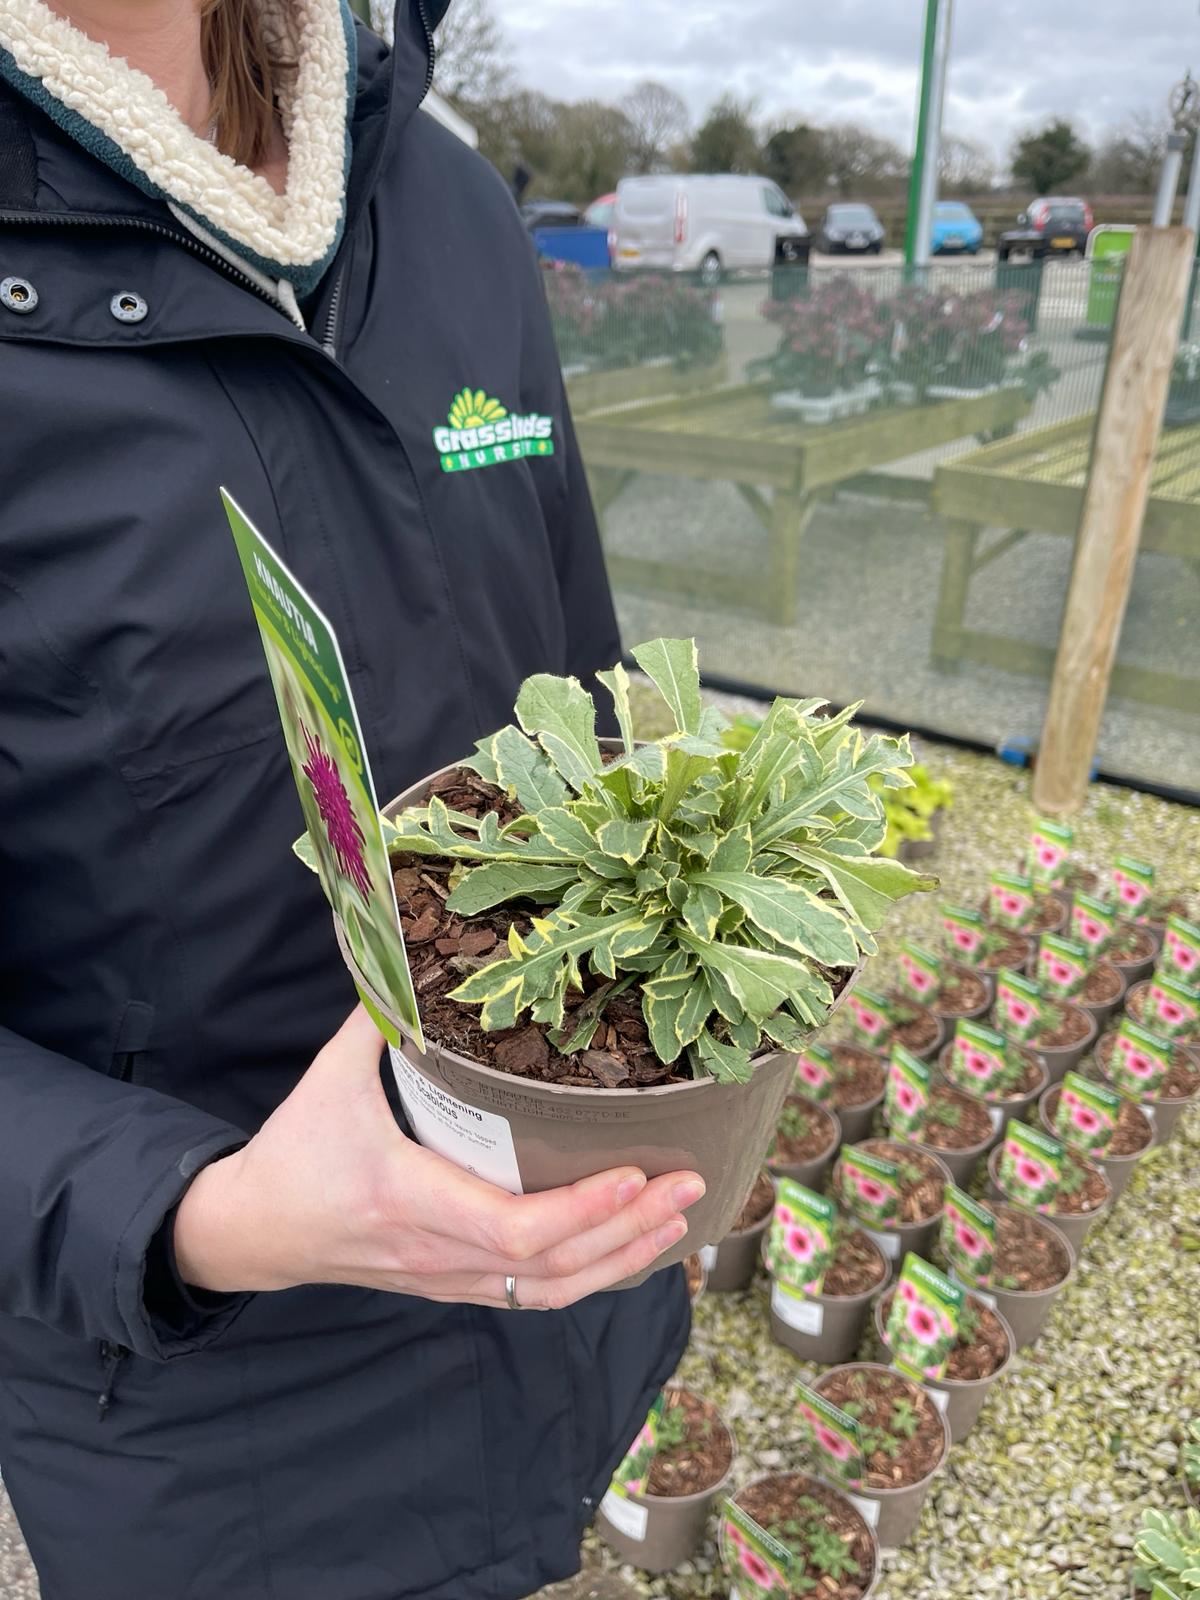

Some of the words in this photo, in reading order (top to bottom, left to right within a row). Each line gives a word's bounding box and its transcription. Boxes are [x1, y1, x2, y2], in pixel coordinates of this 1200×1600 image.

[253, 551, 319, 656] KNAUTIA
[416, 1079, 458, 1120] Scabious
[428, 1083, 483, 1122] Lightening
